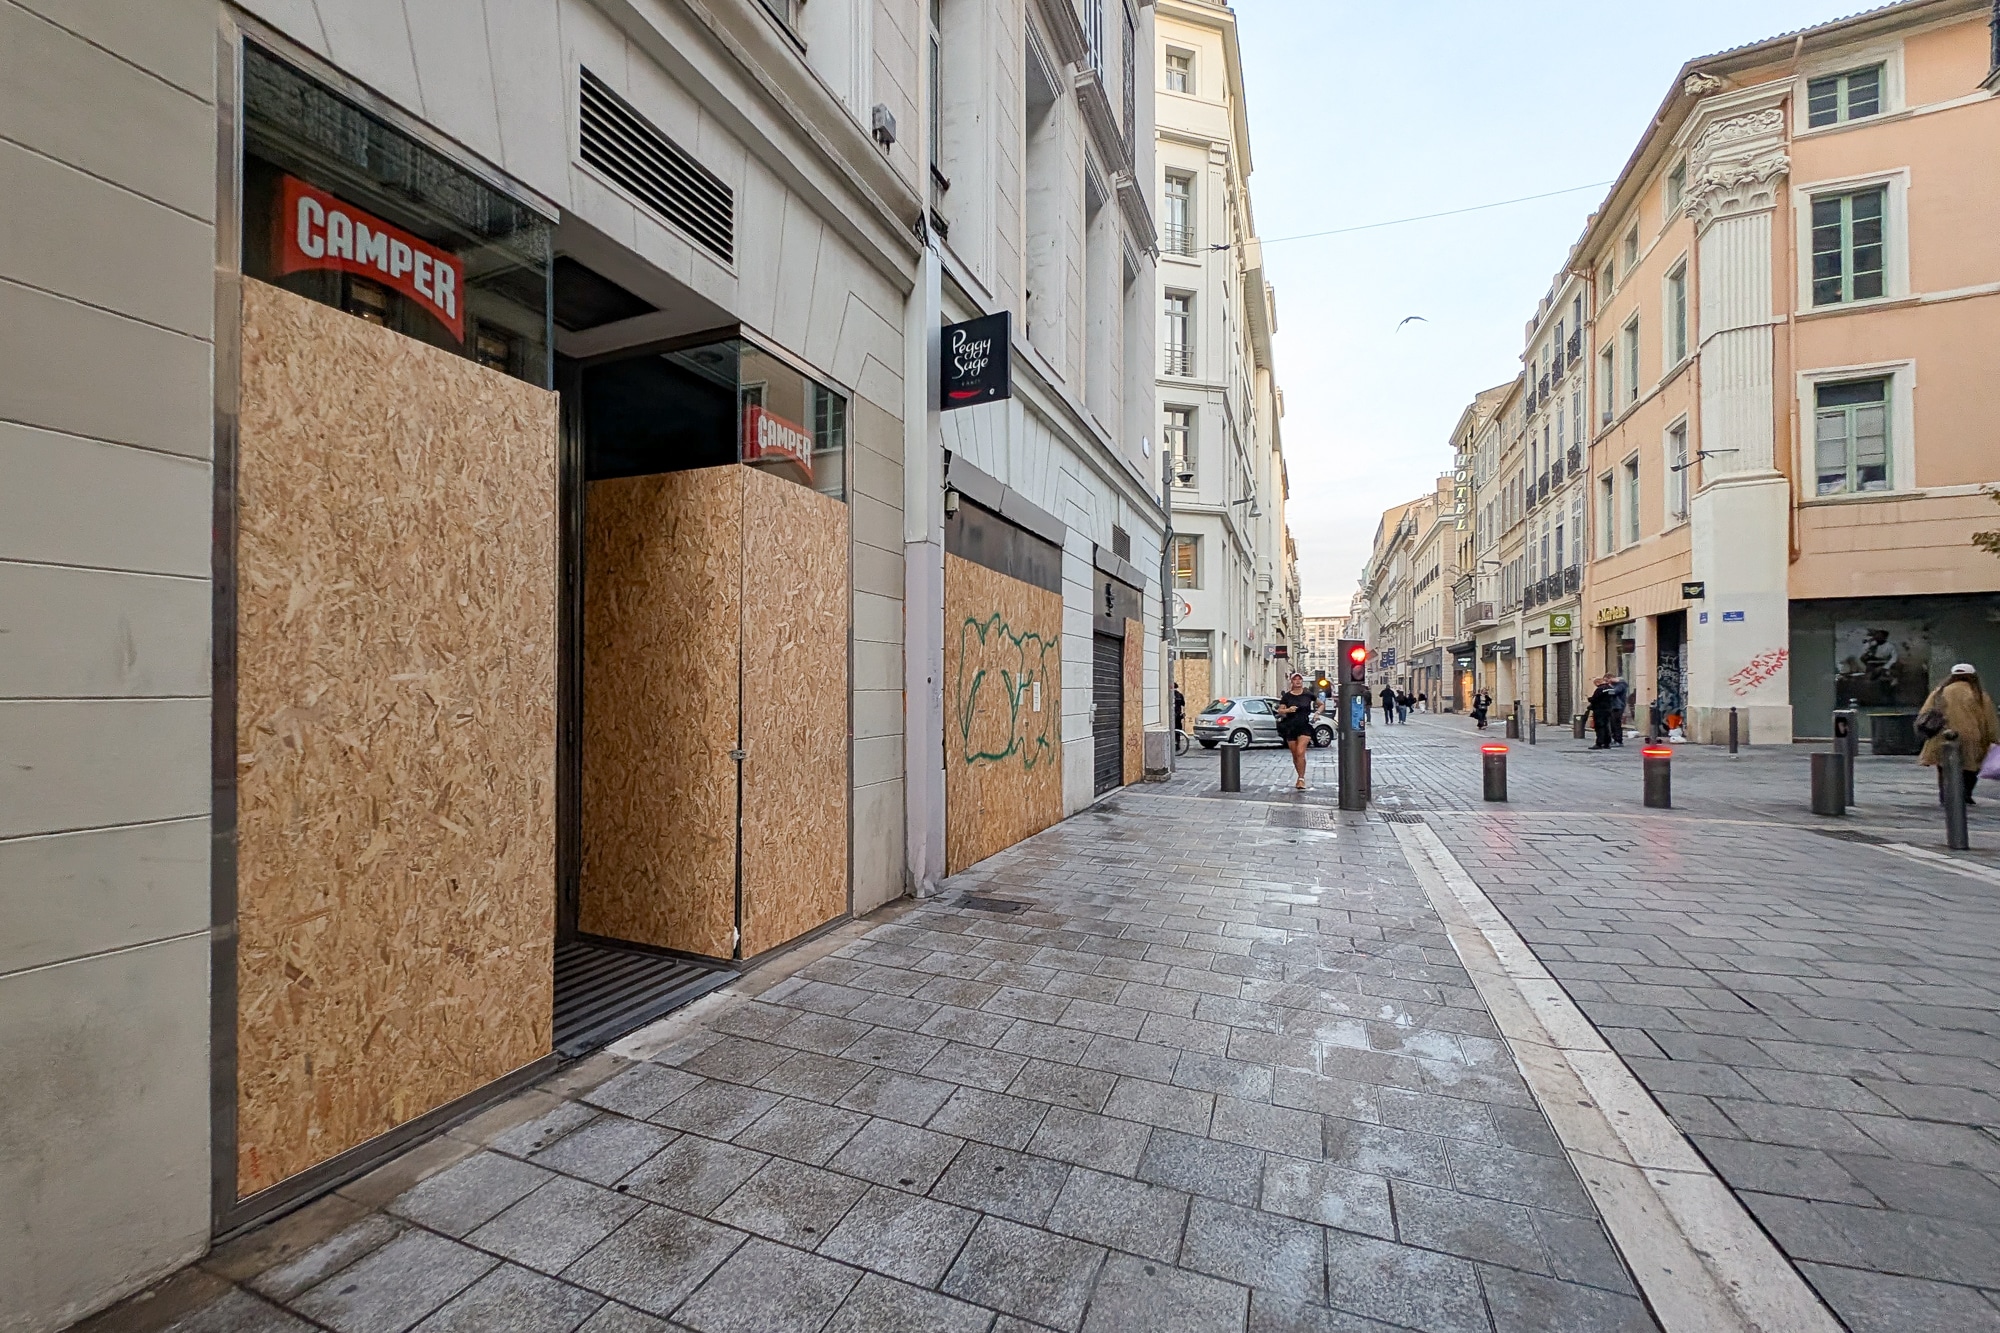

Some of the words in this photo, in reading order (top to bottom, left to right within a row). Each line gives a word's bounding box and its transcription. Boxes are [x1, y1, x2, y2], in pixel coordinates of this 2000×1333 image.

[297, 196, 456, 319] CAMPER
[952, 329, 991, 360] Peggy
[952, 356, 989, 379] Sage
[758, 414, 812, 470] CAMPER
[1455, 455, 1468, 531] HOTEL
